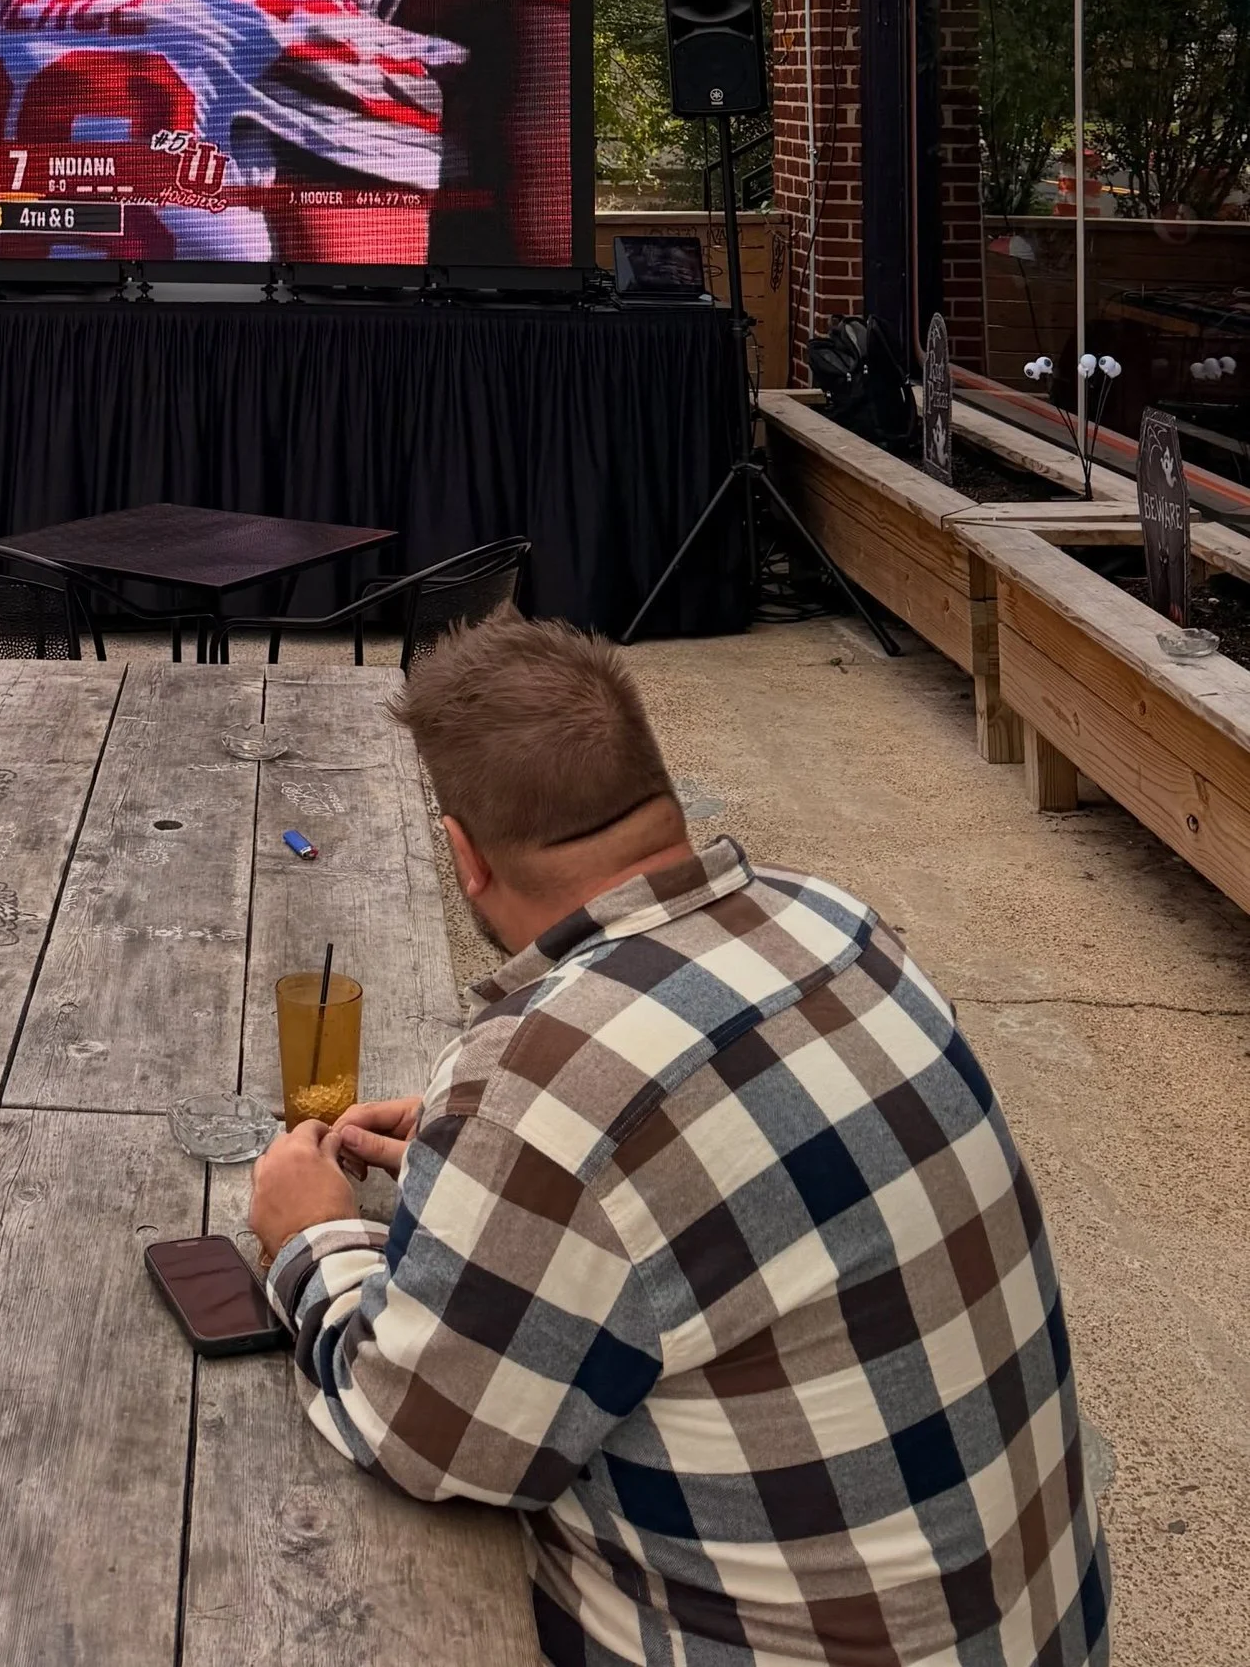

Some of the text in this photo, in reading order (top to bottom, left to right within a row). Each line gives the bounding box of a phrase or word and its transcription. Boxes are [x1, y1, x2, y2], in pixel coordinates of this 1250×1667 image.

[152, 131, 191, 152] #5
[9, 150, 116, 191] 7 INDIANA
[300, 191, 343, 205] HOOVER
[19, 207, 46, 227] 4TH
[49, 207, 62, 228] &
[64, 207, 75, 228] 6
[1142, 490, 1183, 531] BEWARE
